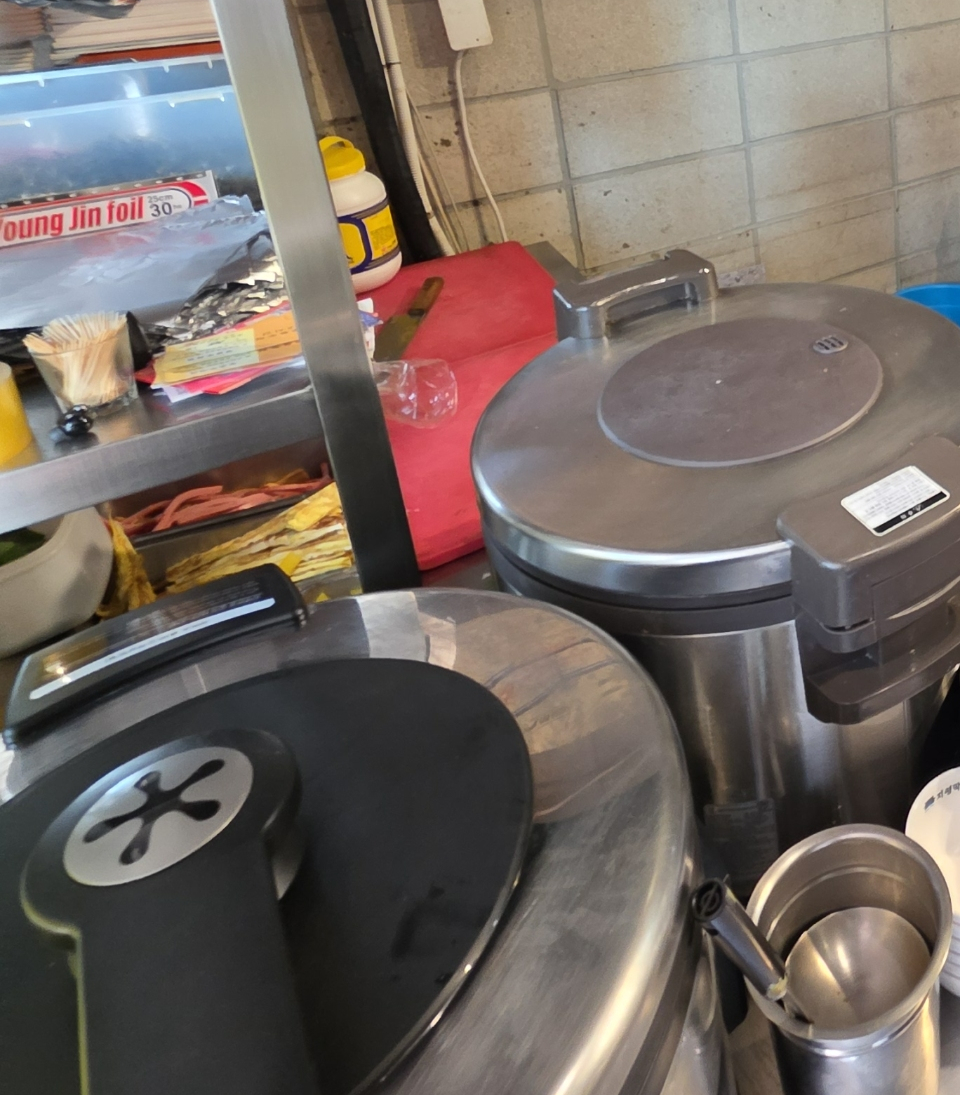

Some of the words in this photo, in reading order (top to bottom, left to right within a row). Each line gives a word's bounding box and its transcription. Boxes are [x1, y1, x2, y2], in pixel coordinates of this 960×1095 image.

[148, 193, 173, 204] 25cm
[68, 205, 101, 231] Jin
[107, 196, 144, 224] foil
